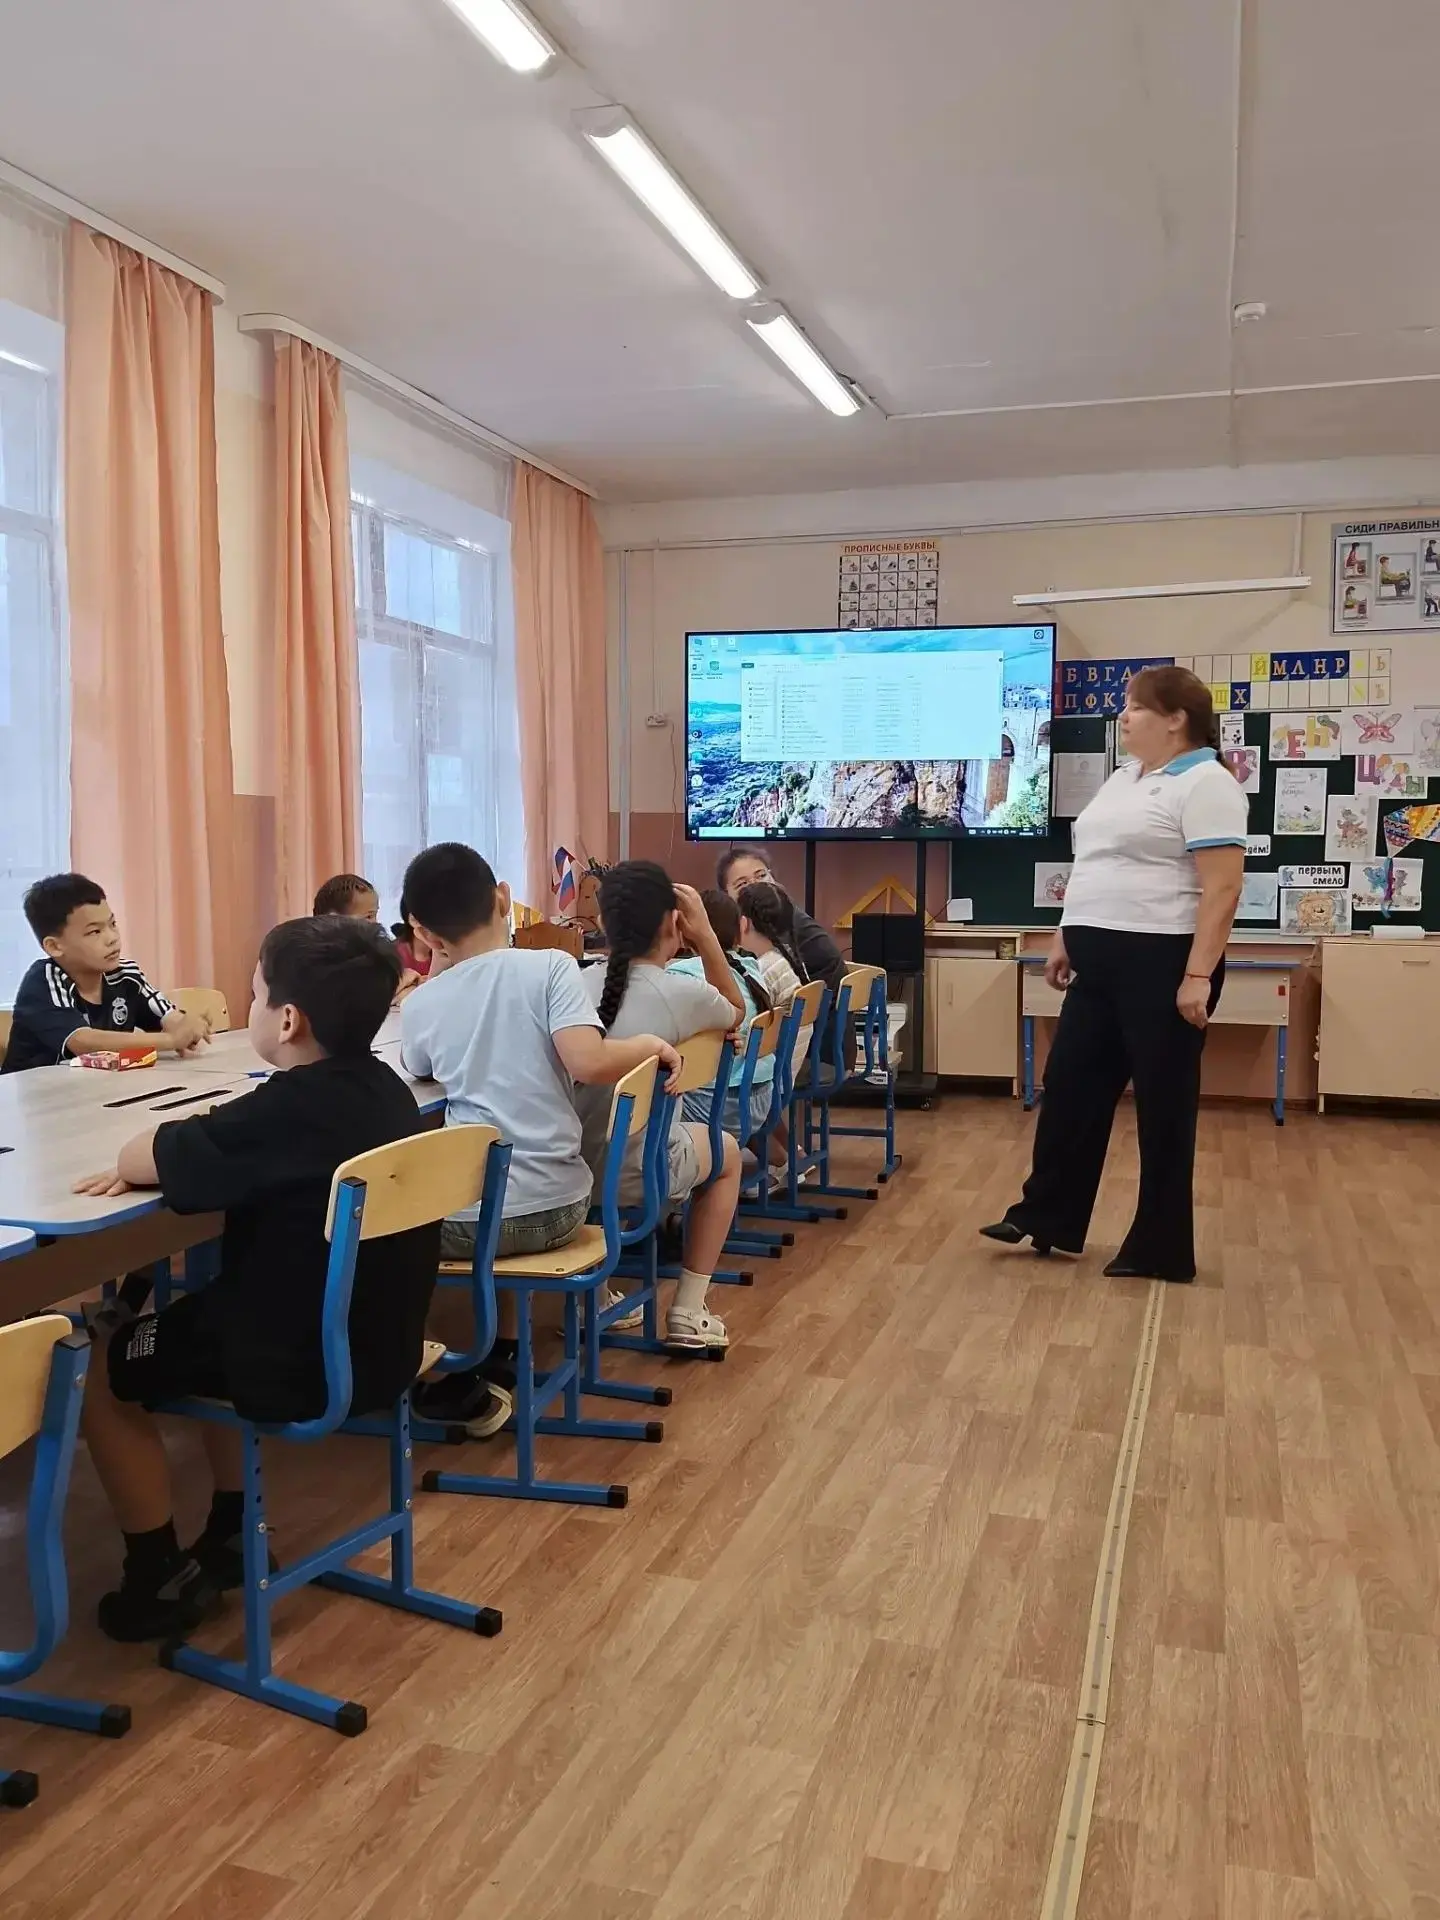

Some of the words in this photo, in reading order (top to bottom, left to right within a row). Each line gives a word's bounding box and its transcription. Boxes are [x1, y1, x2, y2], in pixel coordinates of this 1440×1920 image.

[1345, 523, 1376, 534] СИДИ
[1379, 519, 1440, 532] ПРАВИЛЬН
[844, 543, 901, 553] ПРОПИСНЫЕ
[903, 541, 935, 551] БУКВЫ
[1298, 866, 1342, 876] первым
[1312, 877, 1344, 885] смело
